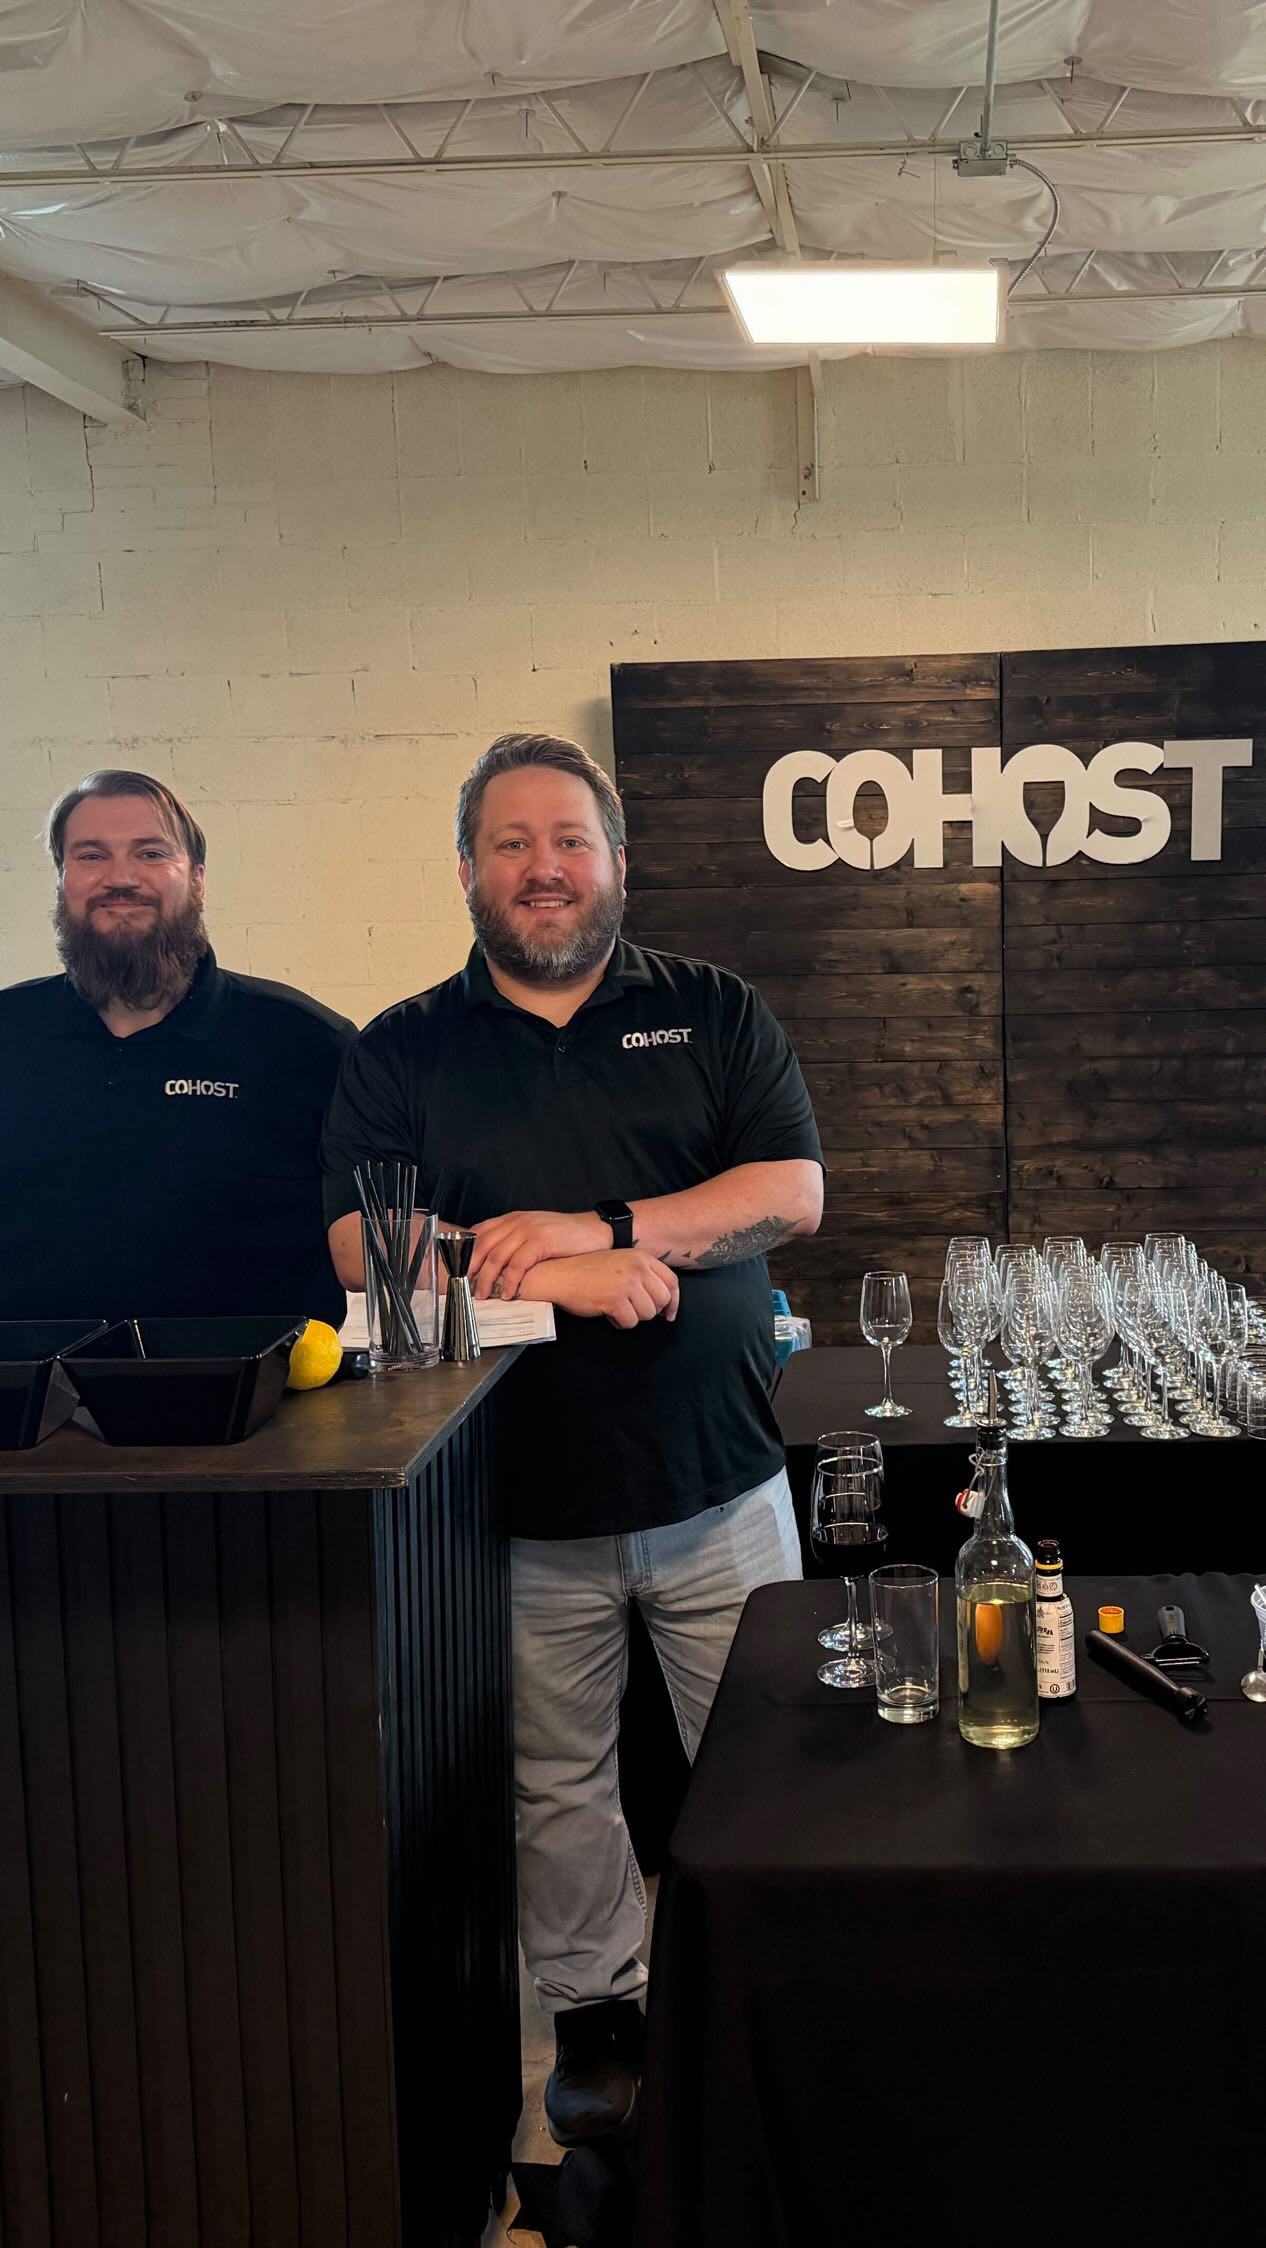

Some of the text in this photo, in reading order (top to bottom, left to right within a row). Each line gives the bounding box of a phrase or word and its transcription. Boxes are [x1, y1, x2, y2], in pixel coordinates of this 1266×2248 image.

[763, 738, 1254, 871] COHOST
[622, 1028, 692, 1049] COHOST
[165, 1079, 239, 1098] COHOST
